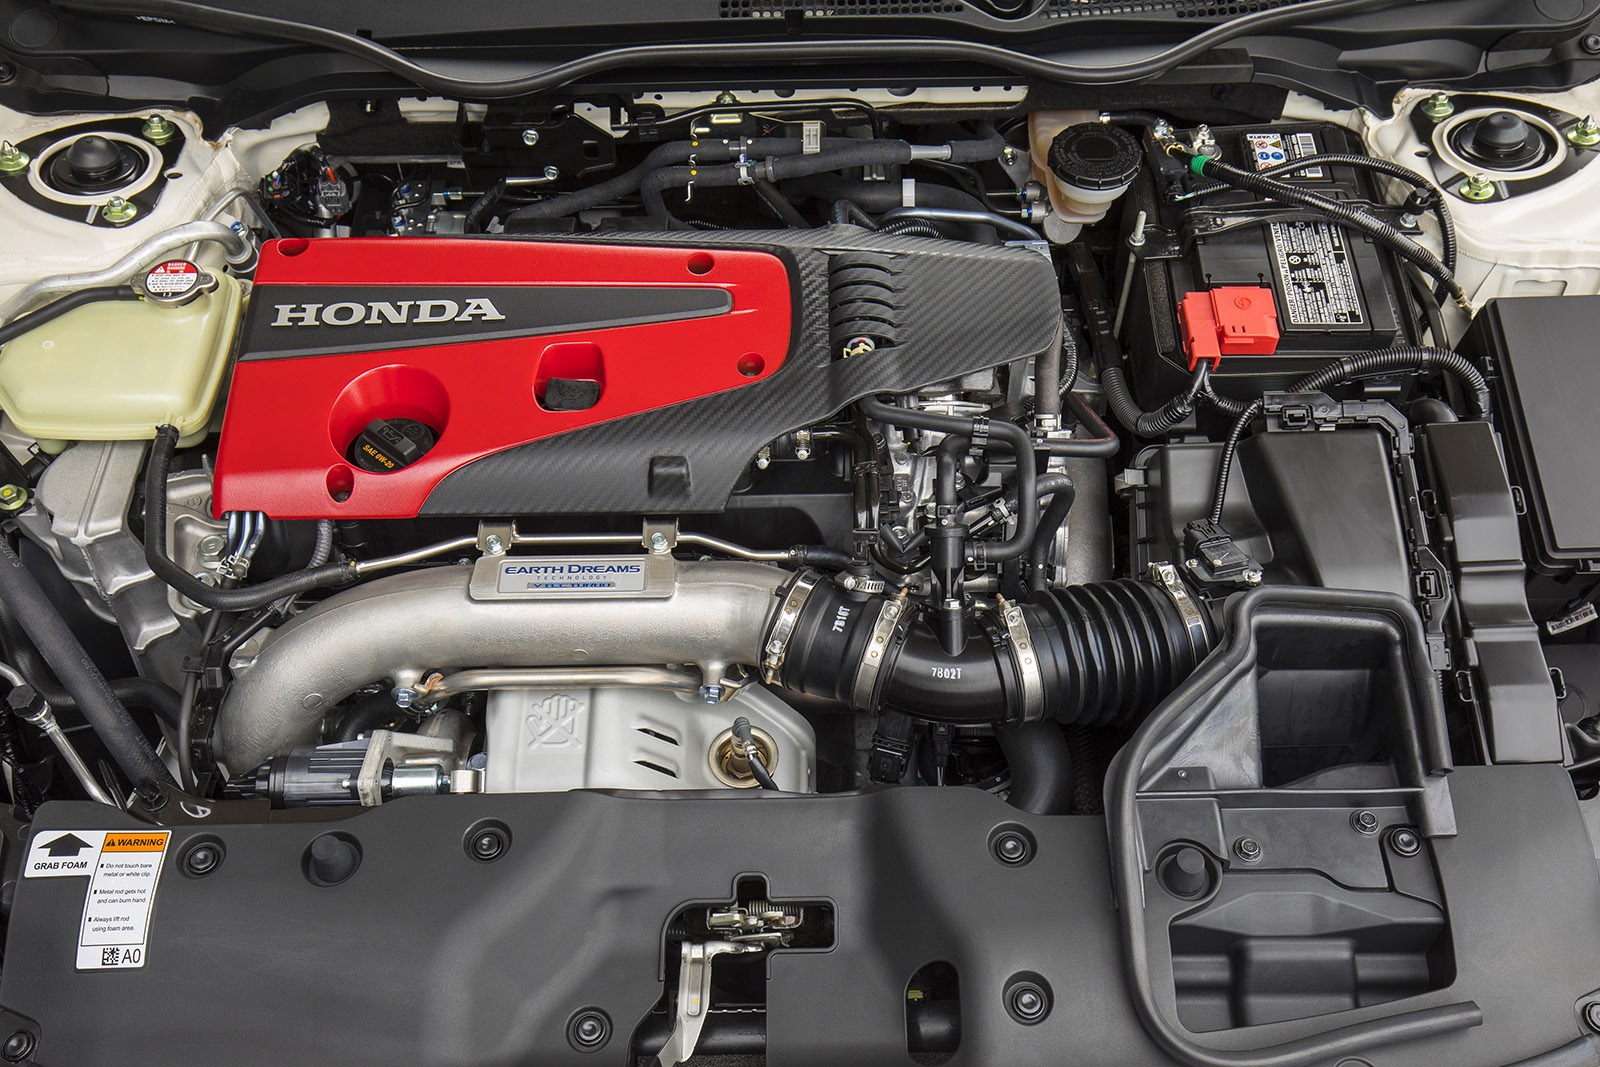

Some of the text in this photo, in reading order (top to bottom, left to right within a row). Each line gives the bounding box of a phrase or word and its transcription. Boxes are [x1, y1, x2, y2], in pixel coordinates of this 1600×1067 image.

[271, 298, 506, 327] HONDA
[362, 444, 395, 469] SAE 0W-20
[504, 564, 641, 575] EARTH DREAMS
[117, 838, 164, 847] WARNING
[33, 861, 88, 870] GRAB FOAM
[121, 948, 141, 964] A0
